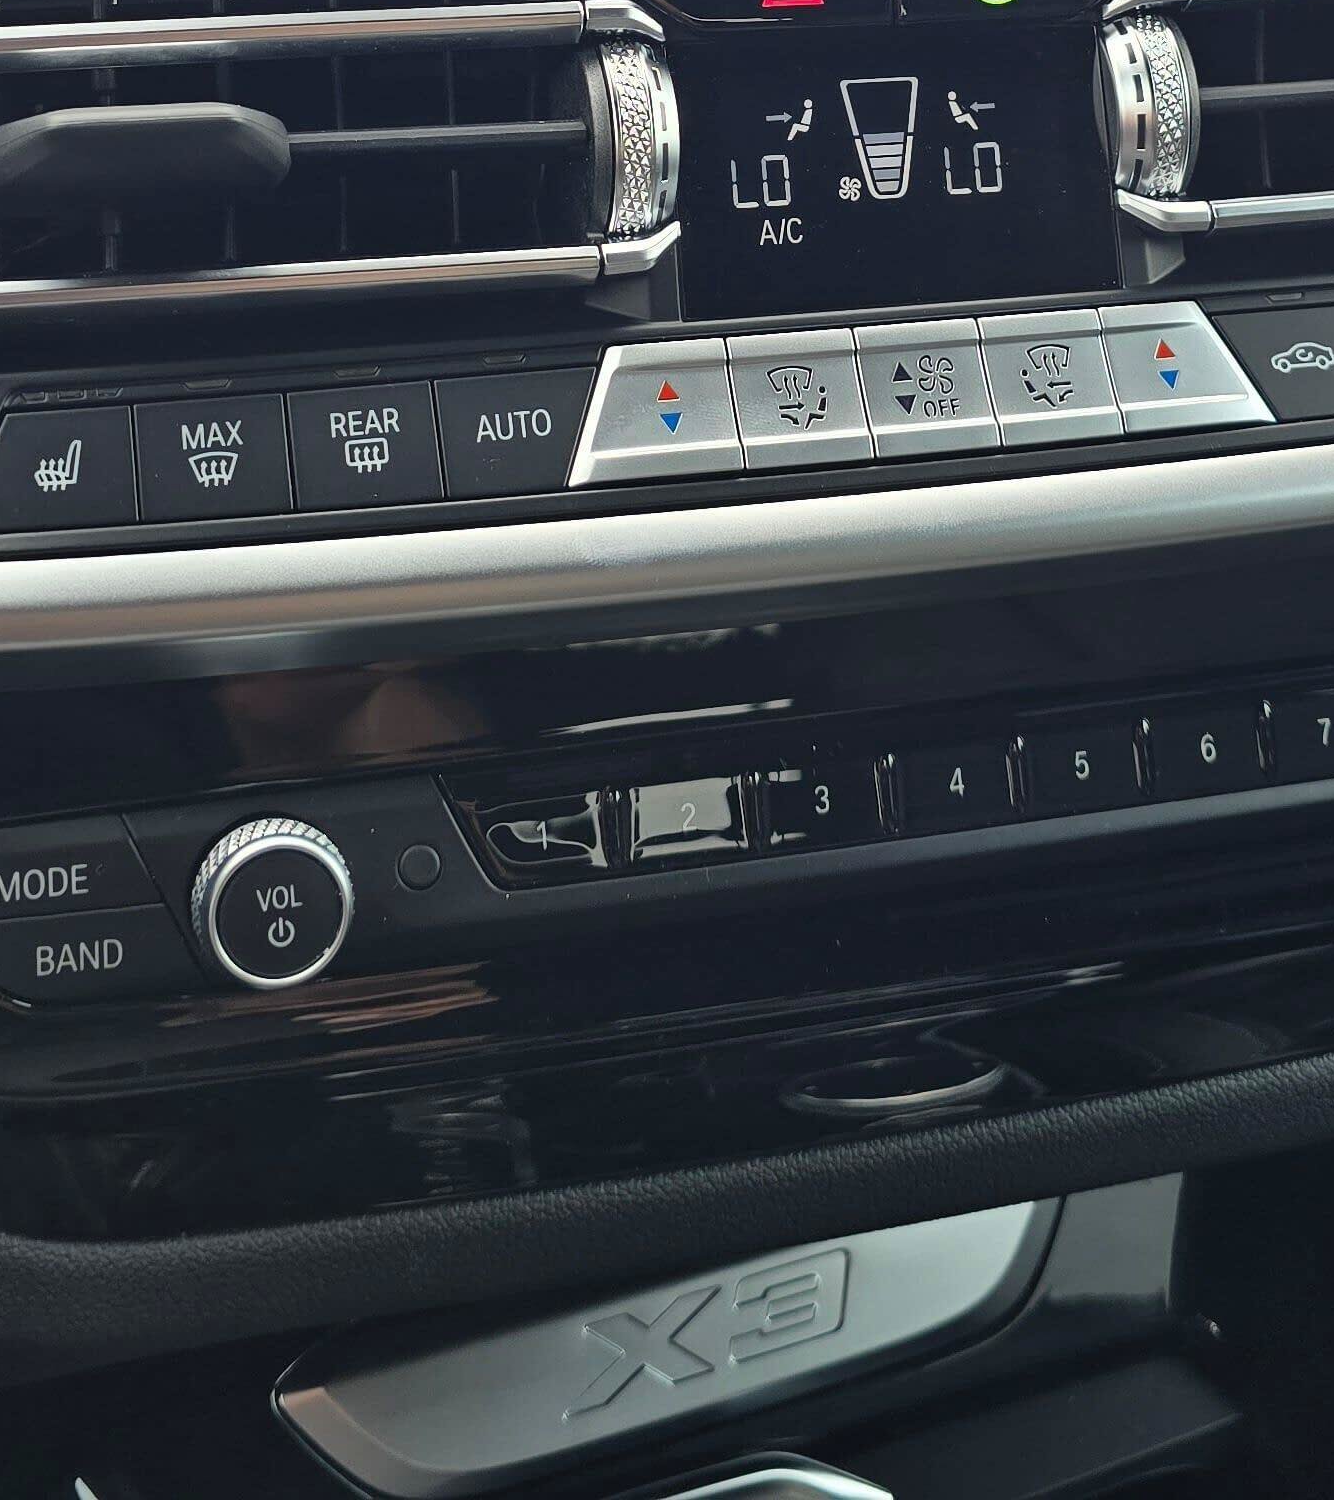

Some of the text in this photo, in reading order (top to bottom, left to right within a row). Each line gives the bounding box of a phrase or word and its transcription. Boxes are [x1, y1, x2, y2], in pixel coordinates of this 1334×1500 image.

[759, 217, 805, 246] A/C
[329, 407, 400, 439] REAR
[924, 399, 961, 418] OFF
[181, 419, 244, 451] MAX
[476, 408, 553, 444] AUTO
[1317, 717, 1332, 745] 7
[1200, 733, 1216, 762] 6
[1074, 750, 1090, 779] 5
[949, 767, 964, 794] 4
[814, 785, 830, 813] 3
[680, 803, 696, 830] 2
[535, 820, 548, 849] 1
[256, 884, 304, 913] VOL
[34, 939, 124, 977] BAND
[562, 1246, 852, 1421] X3
